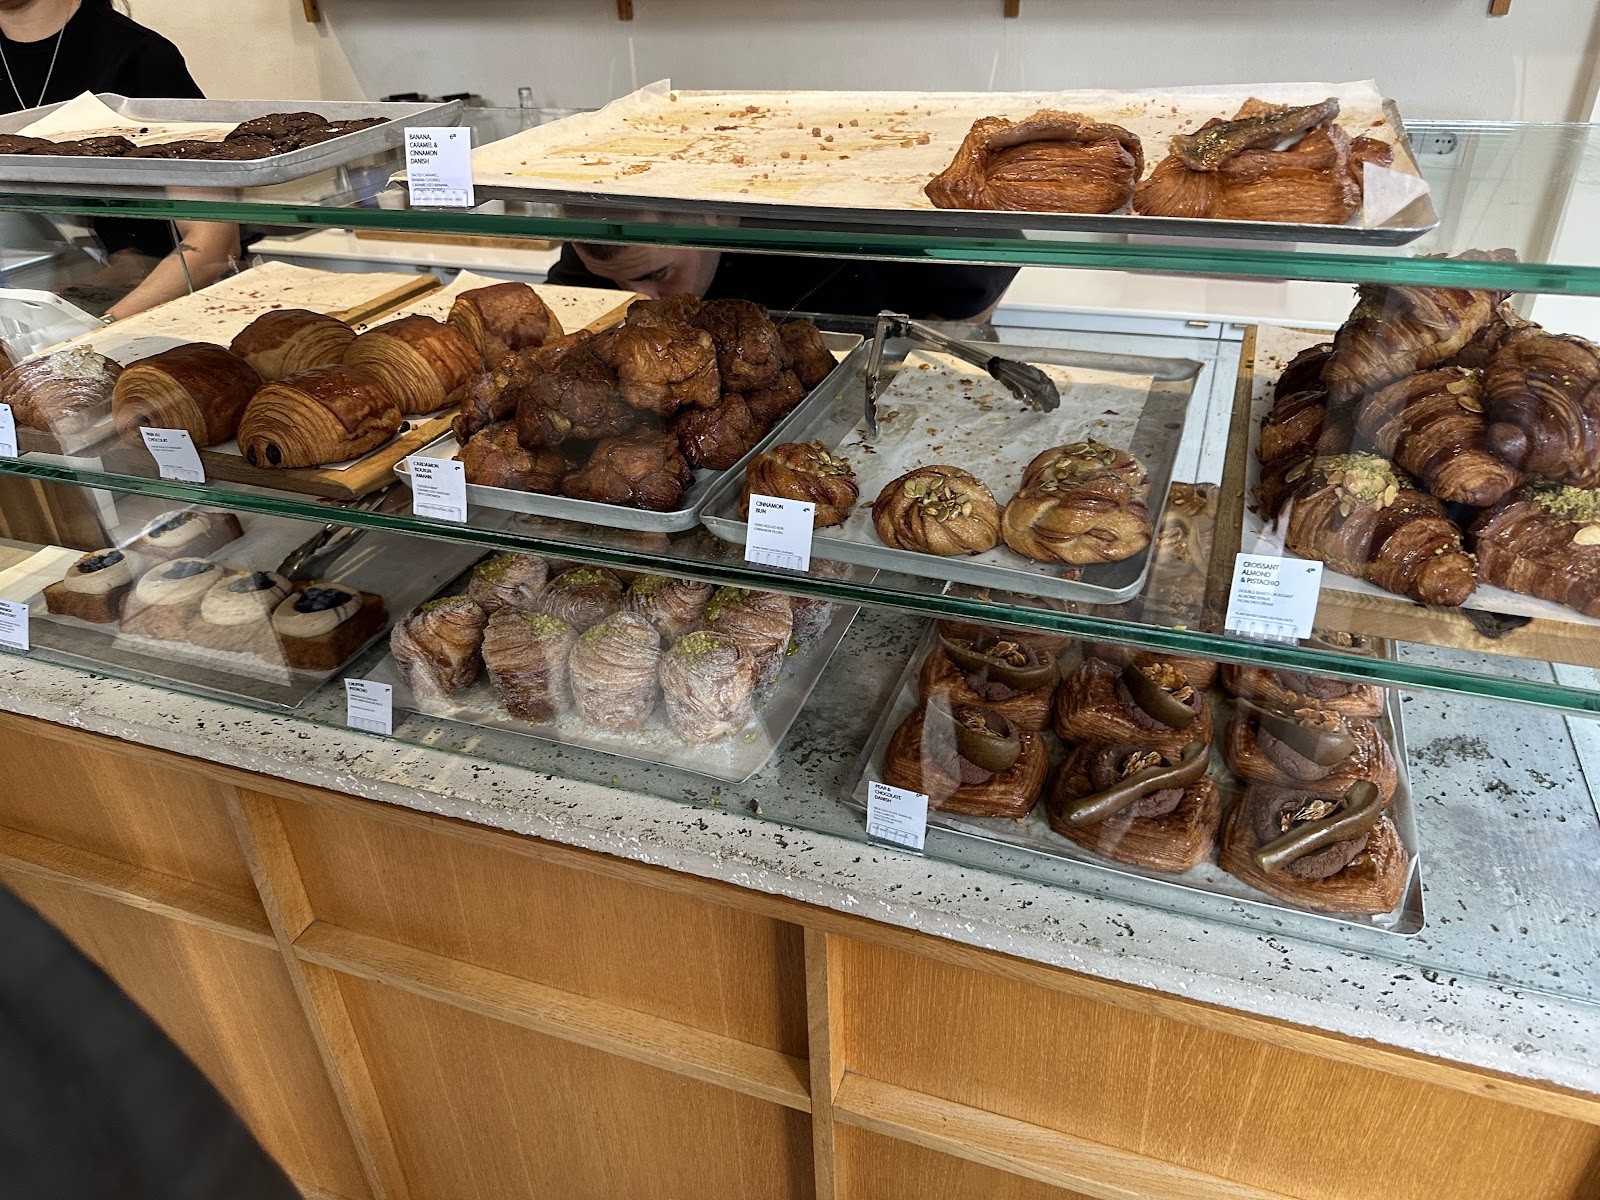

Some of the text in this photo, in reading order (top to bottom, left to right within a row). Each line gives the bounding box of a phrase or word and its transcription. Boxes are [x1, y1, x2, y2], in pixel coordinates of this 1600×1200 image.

[756, 501, 783, 510] CINNAMON
[1243, 562, 1280, 570] CROISSANT
[1242, 569, 1271, 577] ALMOND
[1246, 578, 1280, 586] PISTACHIO
[874, 790, 902, 800] CHOCOLATE
[874, 795, 892, 803] DANISH
